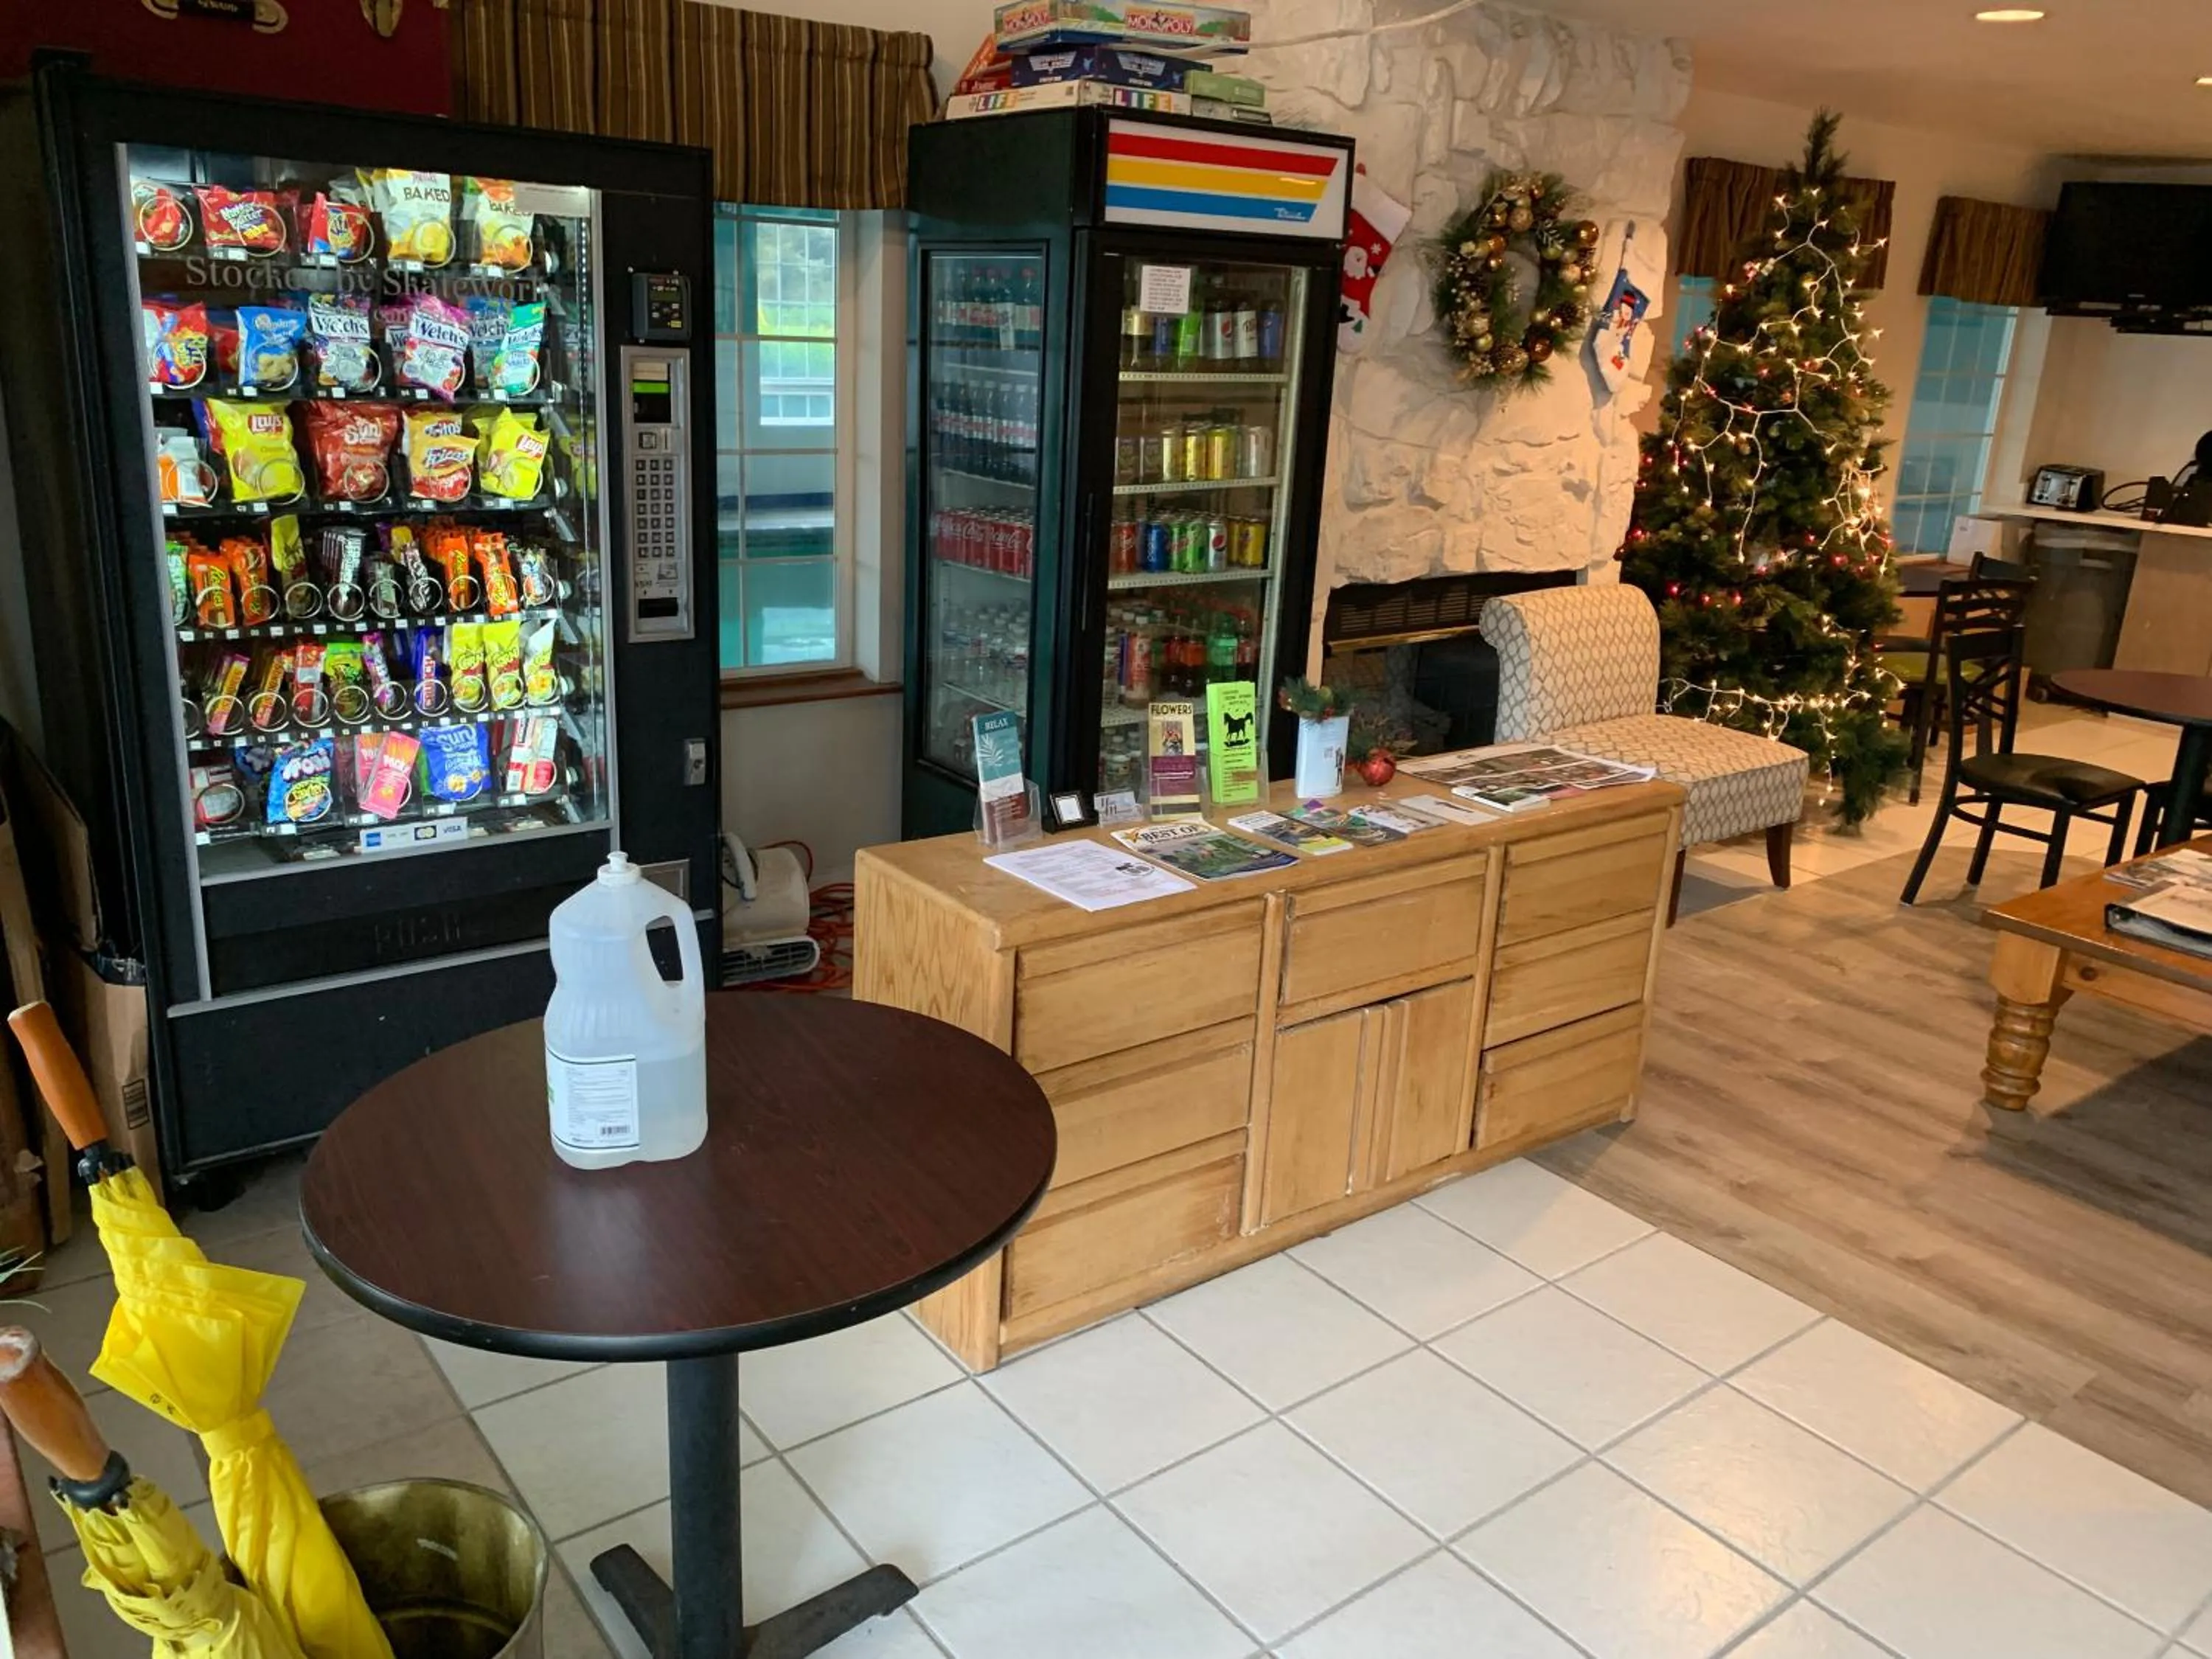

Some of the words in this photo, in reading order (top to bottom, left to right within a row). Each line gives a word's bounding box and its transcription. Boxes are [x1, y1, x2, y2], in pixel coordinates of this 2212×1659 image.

[977, 93, 1018, 111] LIFE
[1114, 88, 1172, 113] LIFE
[403, 187, 451, 202] BAKED
[1150, 703, 1192, 715] FLOWERS
[984, 717, 1009, 731] RELAX
[442, 825, 462, 834] VISA
[1141, 828, 1176, 842] BEST
